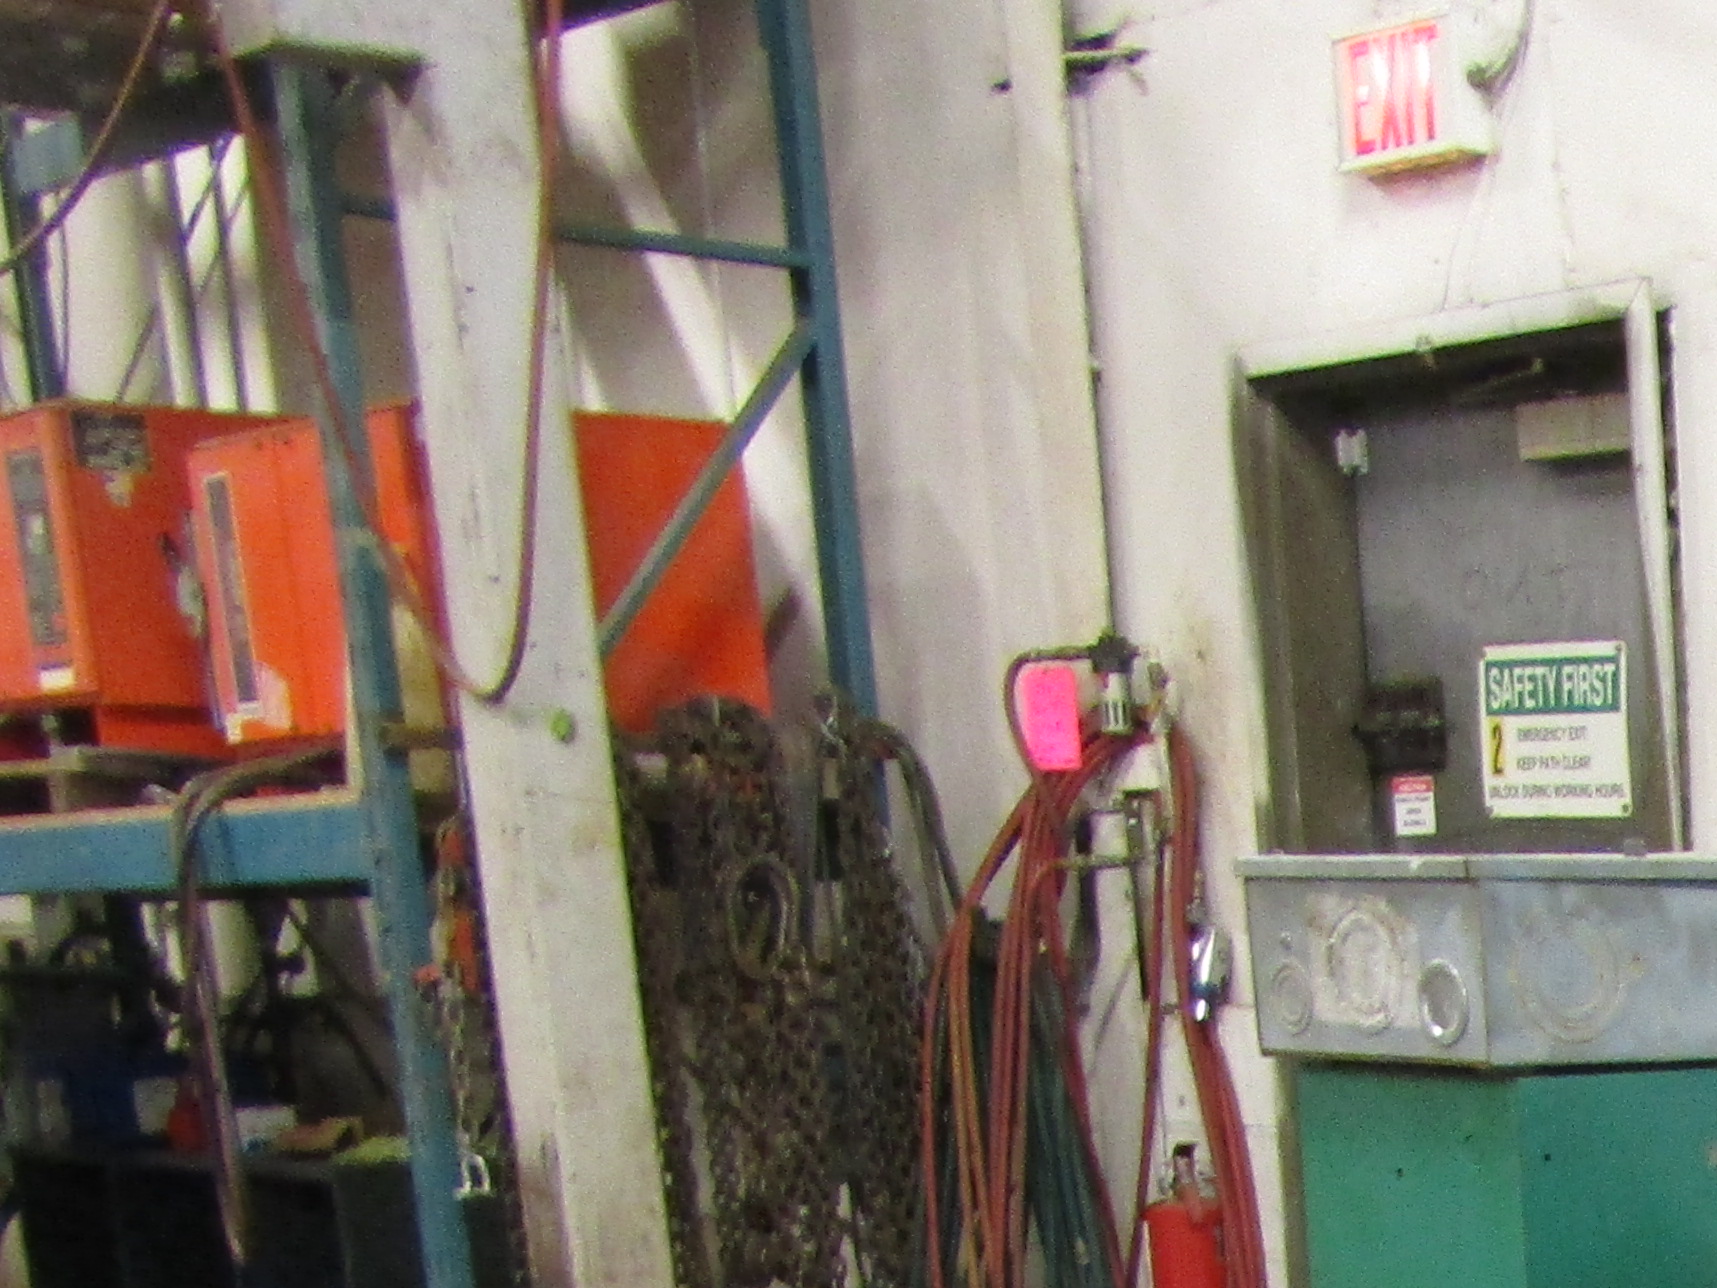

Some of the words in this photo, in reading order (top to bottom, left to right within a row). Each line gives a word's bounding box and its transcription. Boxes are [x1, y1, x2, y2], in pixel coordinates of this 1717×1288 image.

[1349, 25, 1438, 156] EXIT
[1488, 664, 1557, 710] SAFETY
[1561, 661, 1617, 707] FIRST
